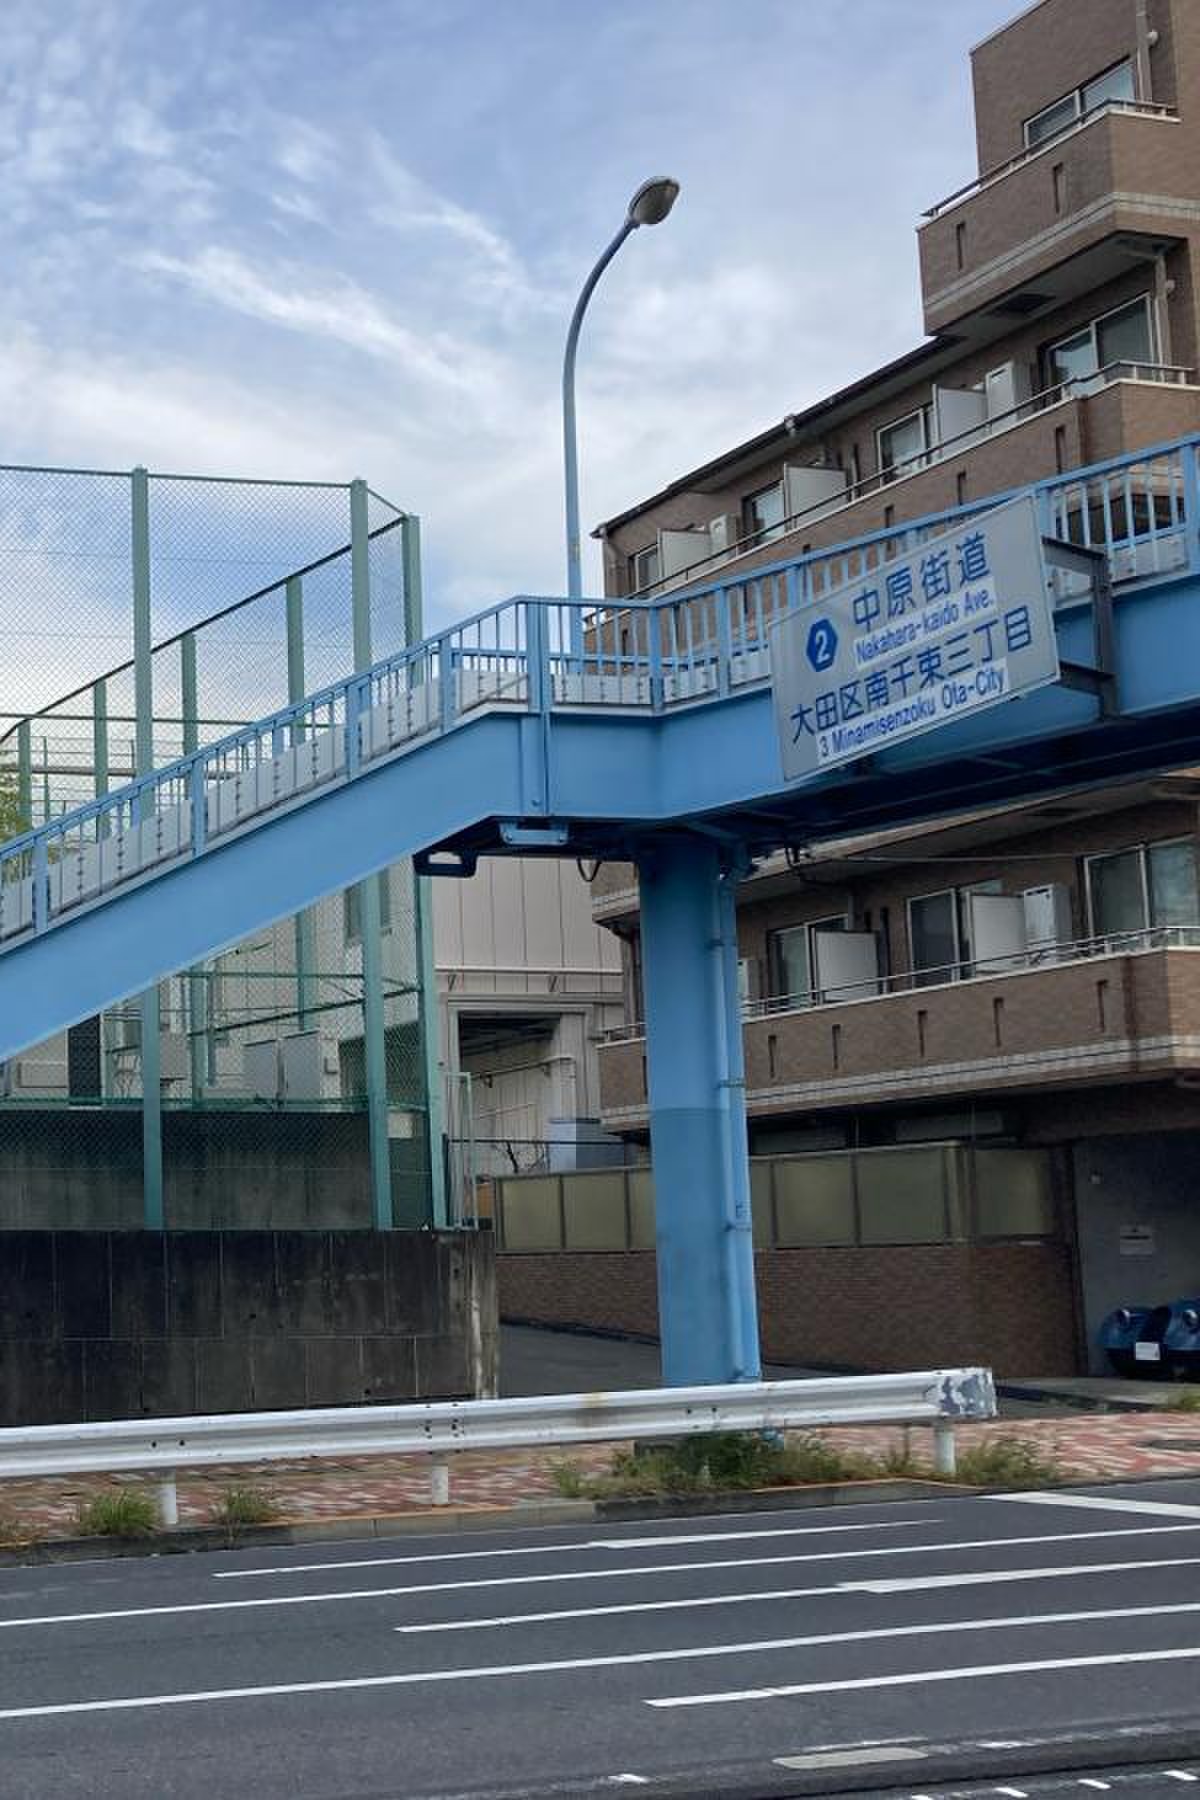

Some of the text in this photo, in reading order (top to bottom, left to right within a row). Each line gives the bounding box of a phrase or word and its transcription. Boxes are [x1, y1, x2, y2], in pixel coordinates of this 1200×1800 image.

[853, 531, 990, 633] 中原街道
[856, 589, 994, 664] Nakahara-kaido Ave.
[790, 605, 1032, 744] 大田区南千束三丁目
[815, 630, 830, 663] 2
[818, 667, 1004, 758] 3 Minamisenzoku Ota-City
